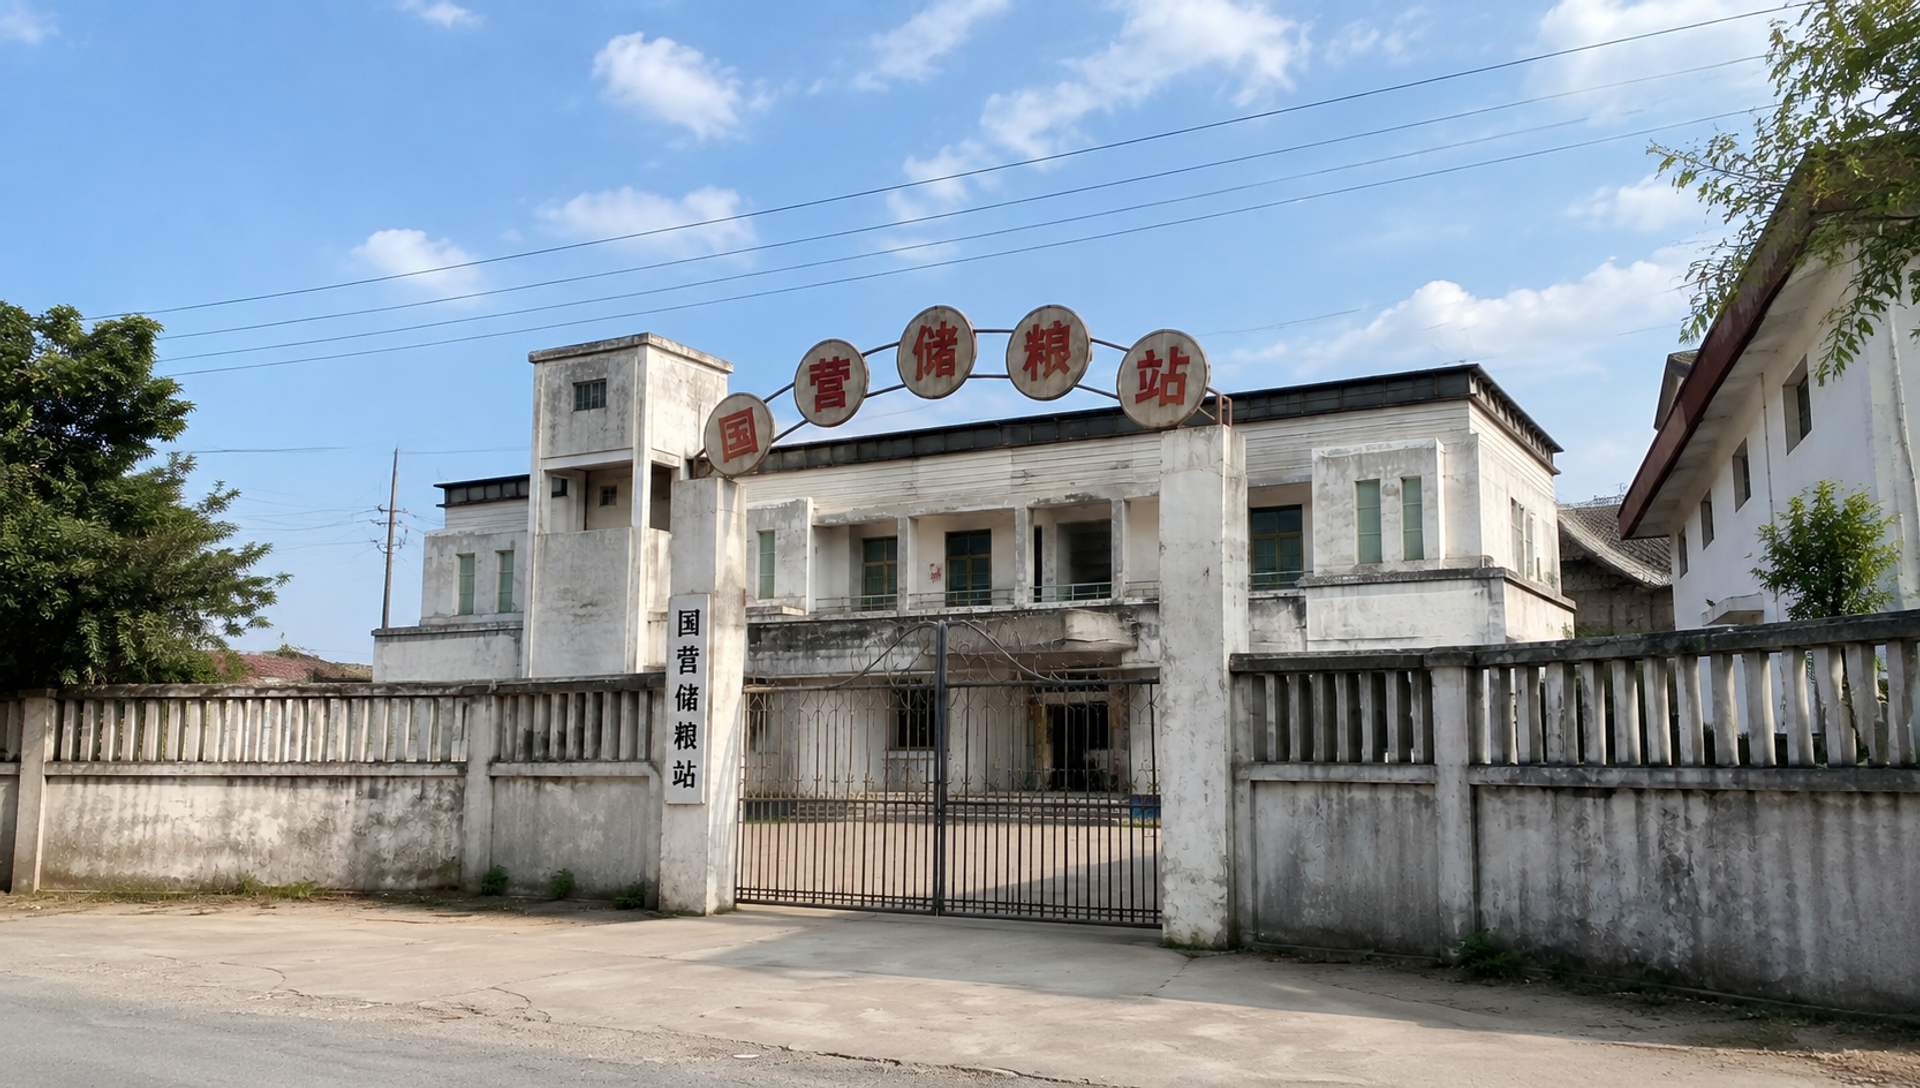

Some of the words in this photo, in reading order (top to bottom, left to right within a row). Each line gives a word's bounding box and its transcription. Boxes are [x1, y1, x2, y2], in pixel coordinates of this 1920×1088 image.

[718, 319, 1190, 463] 国营储粮站
[672, 608, 701, 789] 国营储粮站
